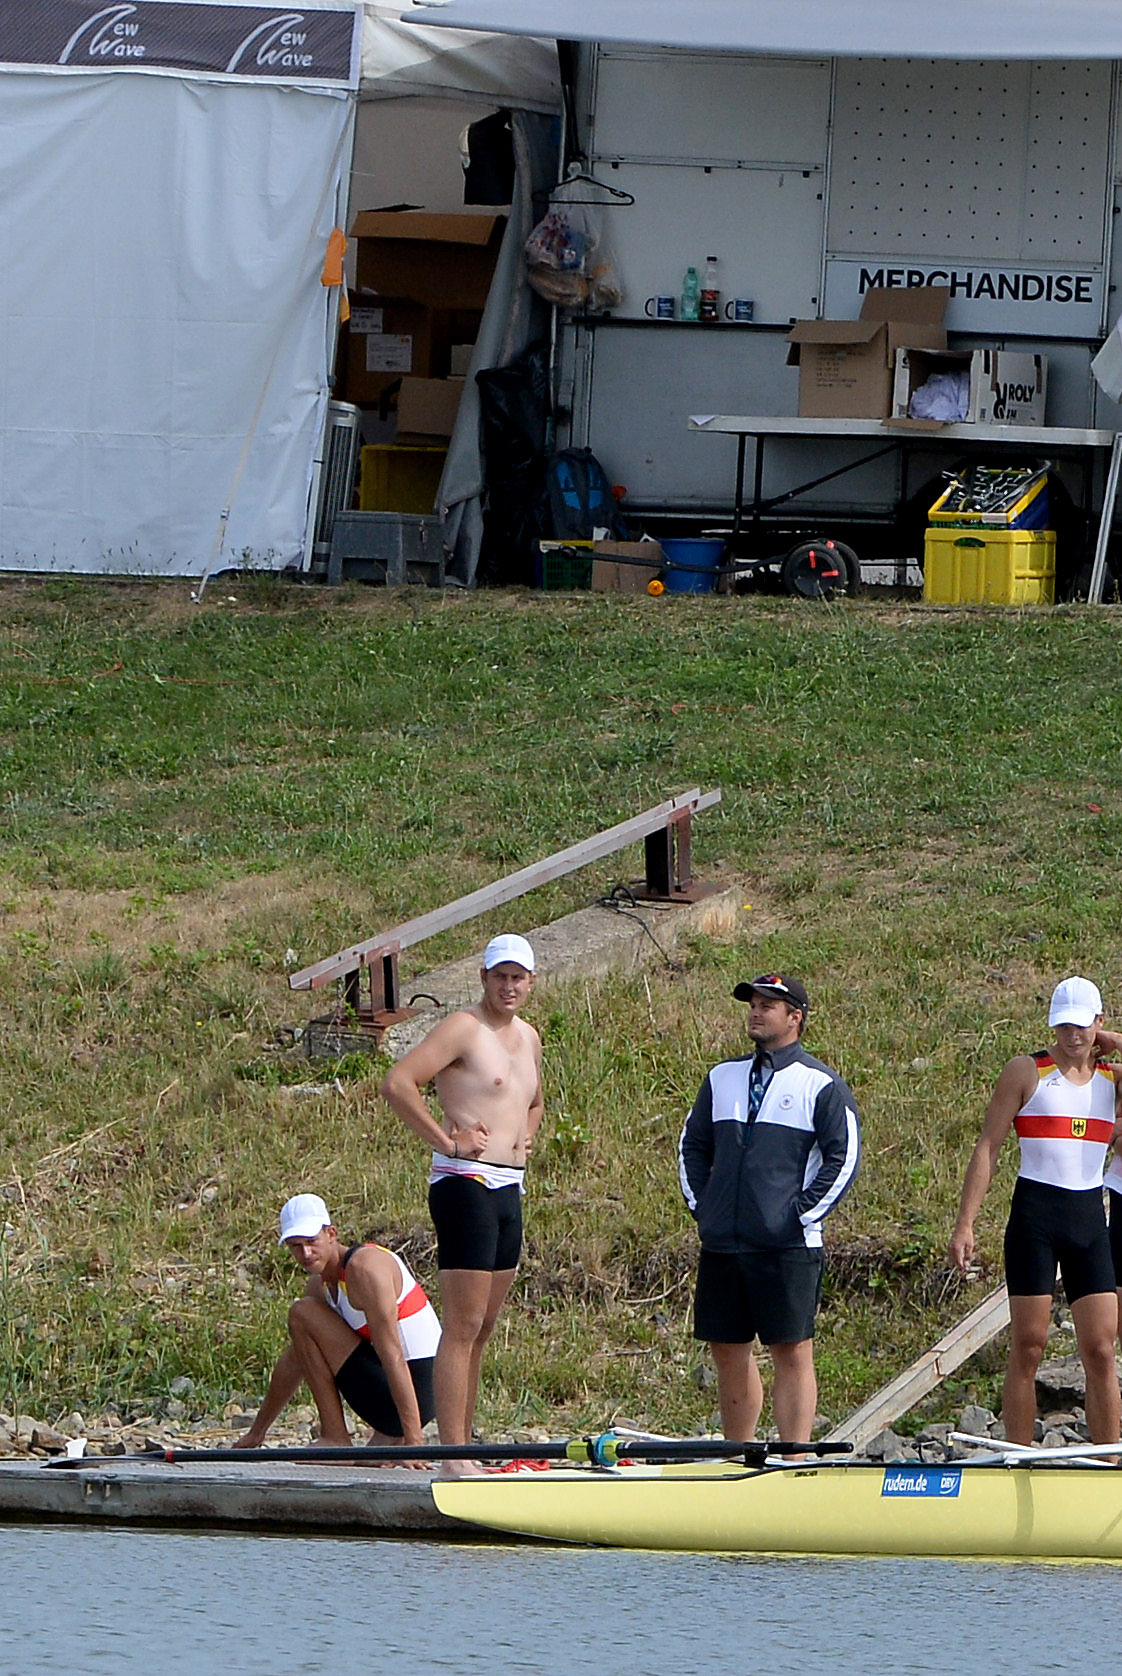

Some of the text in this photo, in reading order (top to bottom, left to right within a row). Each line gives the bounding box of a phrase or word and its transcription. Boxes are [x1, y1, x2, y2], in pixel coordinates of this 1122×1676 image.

[858, 268, 1093, 303] MERCHANDISE
[1009, 383, 1035, 402] ROLY
[883, 1473, 927, 1491] rudern.de
